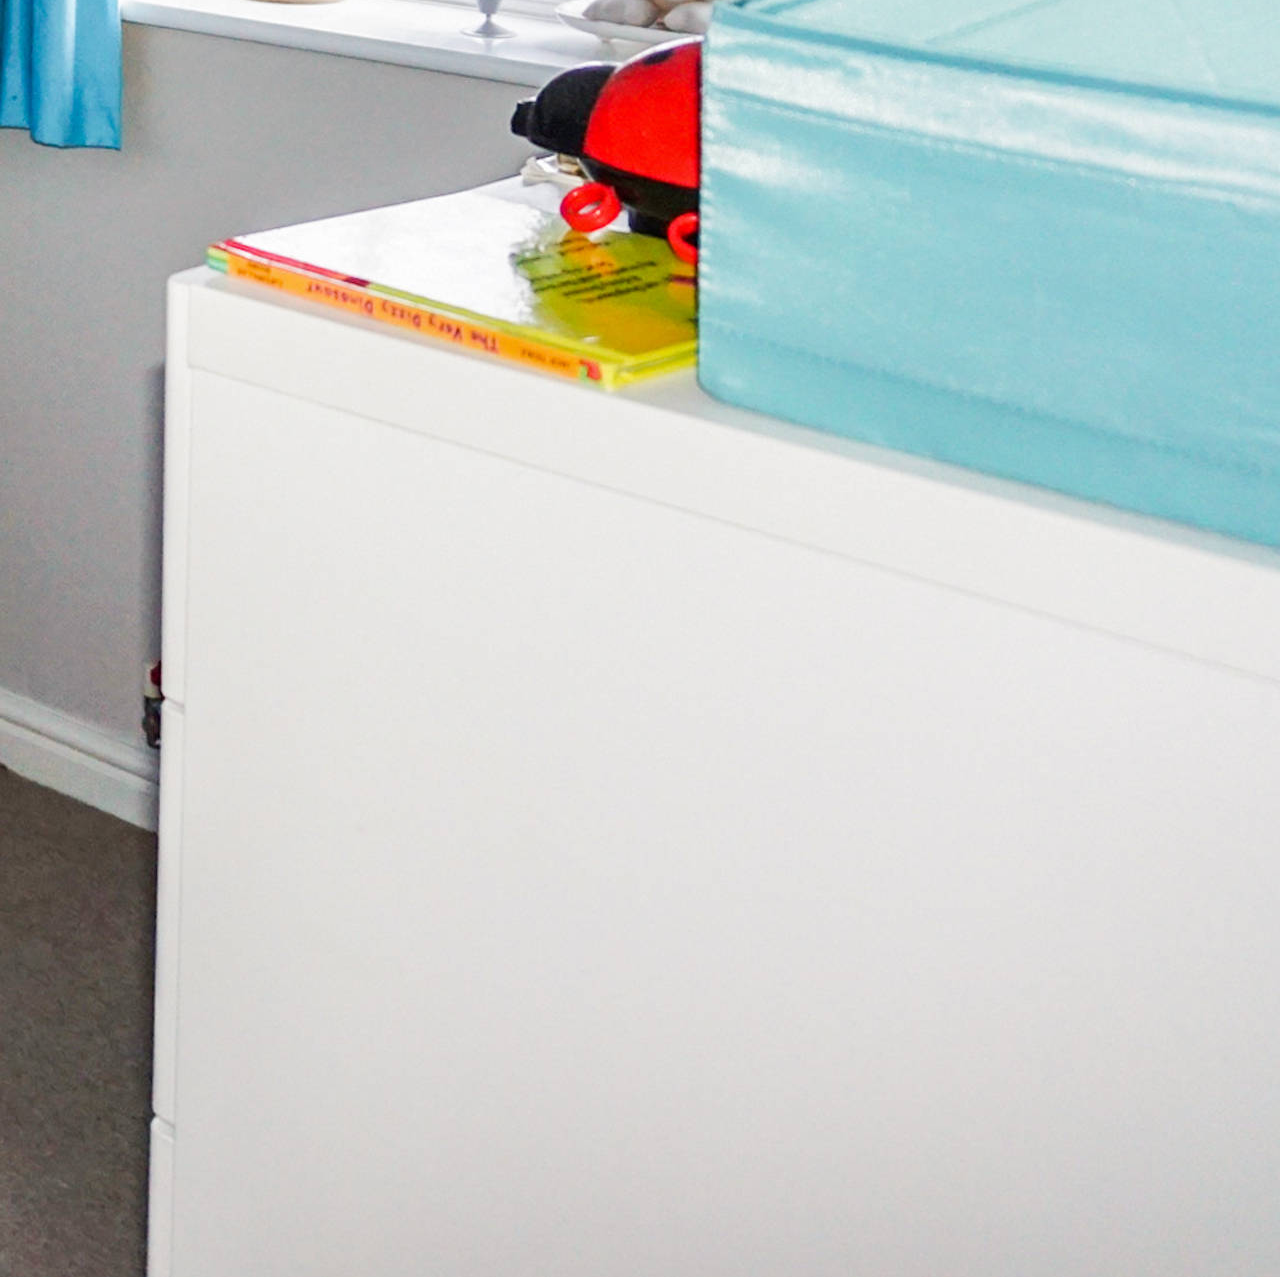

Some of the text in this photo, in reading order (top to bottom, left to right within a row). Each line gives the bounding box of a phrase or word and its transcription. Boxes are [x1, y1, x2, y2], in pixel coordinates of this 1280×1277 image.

[306, 281, 374, 315] Dinosaur
[428, 313, 463, 341] Very
[470, 330, 499, 354] The
